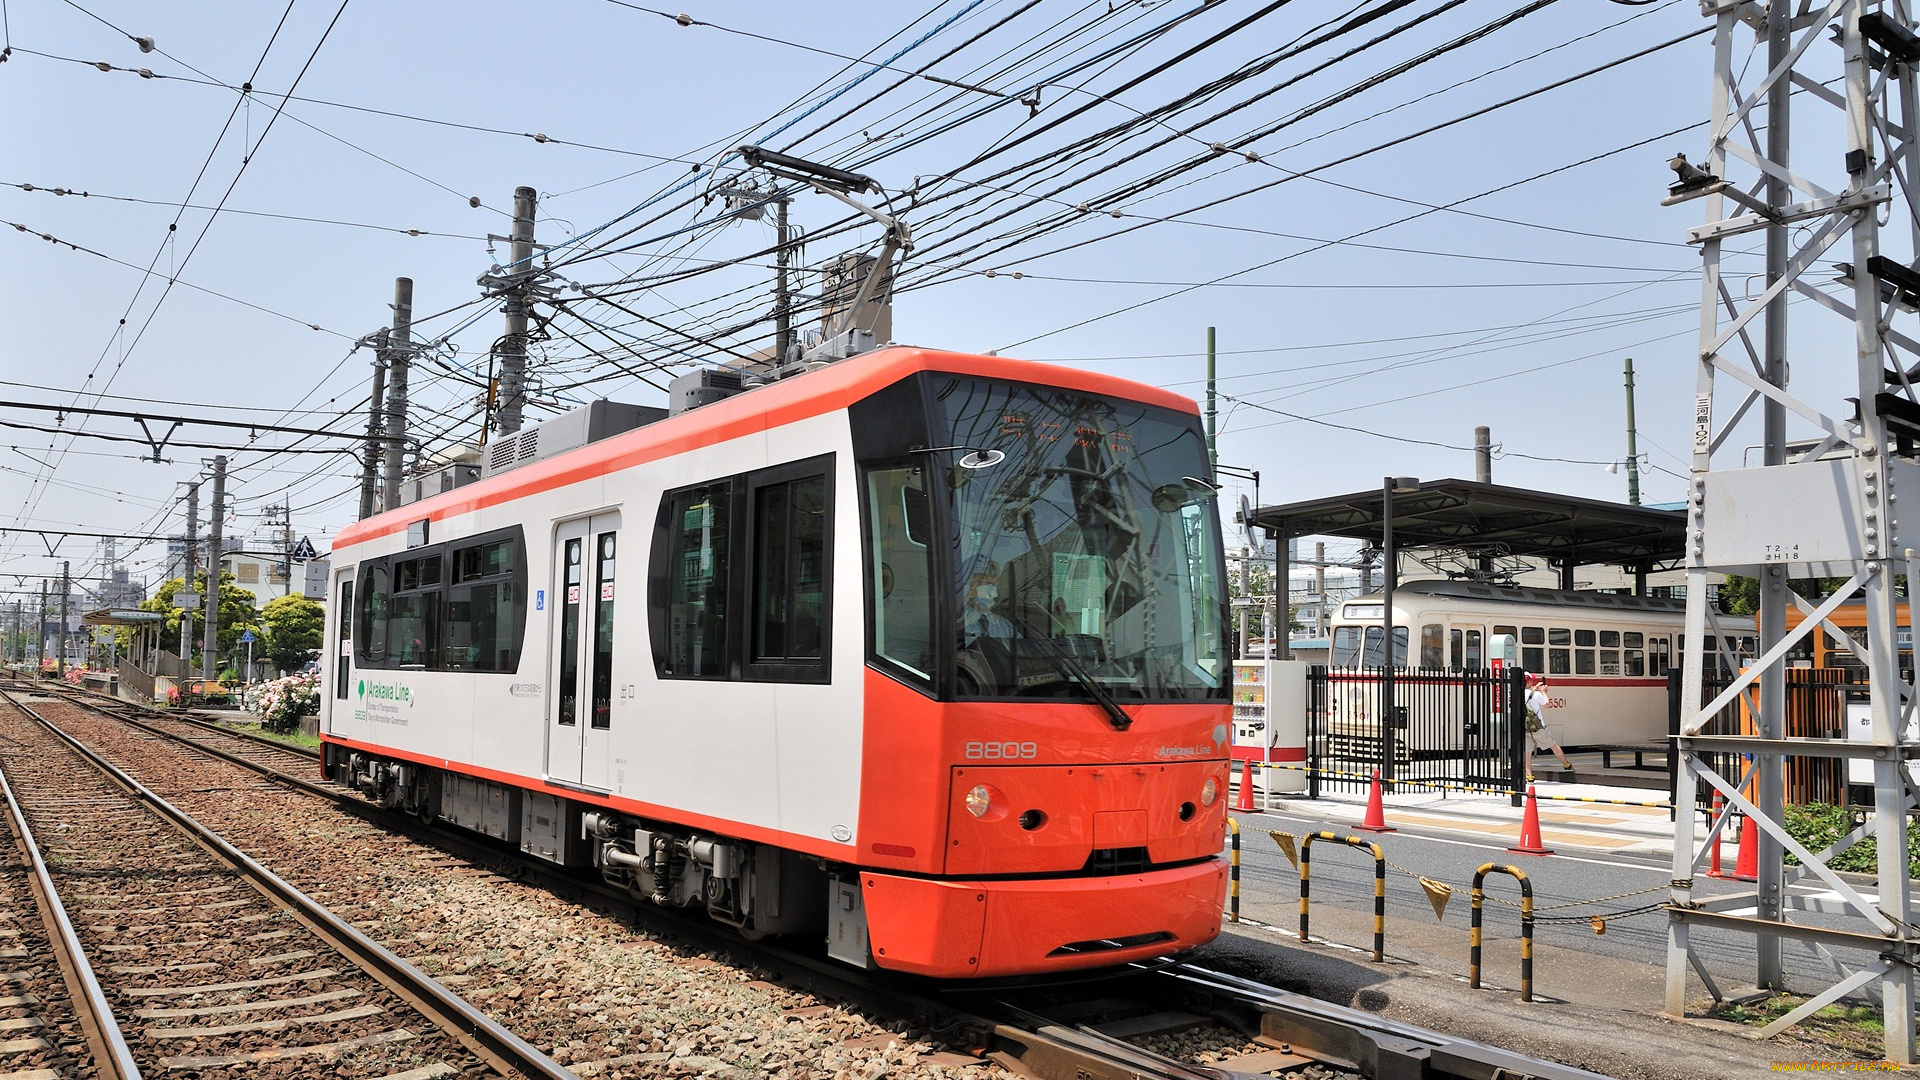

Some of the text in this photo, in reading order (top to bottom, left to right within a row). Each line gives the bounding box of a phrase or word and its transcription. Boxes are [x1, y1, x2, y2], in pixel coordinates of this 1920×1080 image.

[602, 585, 613, 599] 出口
[369, 680, 409, 701] Arakawa Line
[620, 683, 634, 699] 出口
[965, 741, 1038, 759] 8809
[1159, 744, 1212, 757] Arakawa Line
